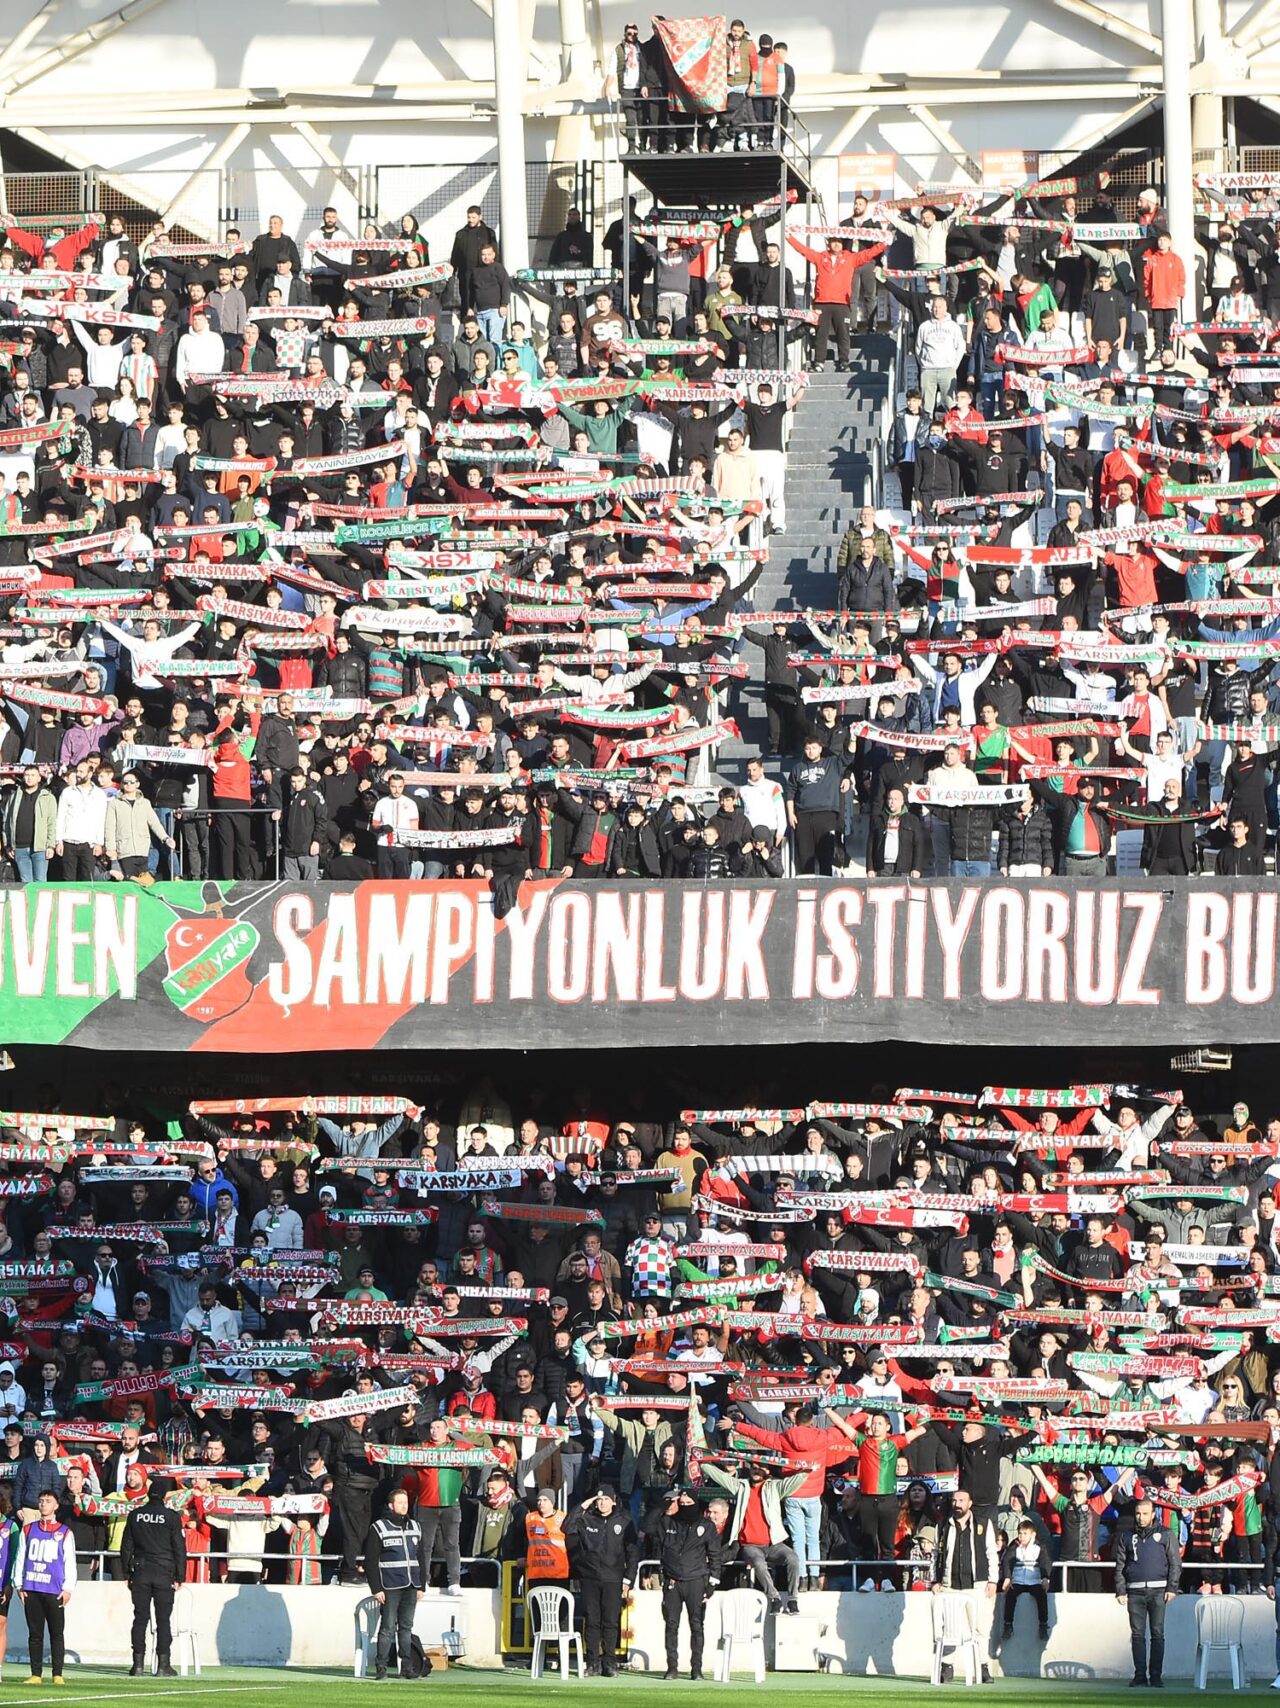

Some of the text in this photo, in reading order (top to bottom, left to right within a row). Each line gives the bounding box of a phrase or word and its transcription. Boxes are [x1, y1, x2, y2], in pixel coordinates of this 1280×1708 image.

[85, 310, 133, 322] KSK
[593, 322, 622, 341] 96
[1184, 891, 1276, 1006] BU
[420, 1173, 497, 1189] KARŞIYAKA
[349, 1212, 412, 1225] KARŞIYAKA
[33, 1562, 47, 1572] TOP
